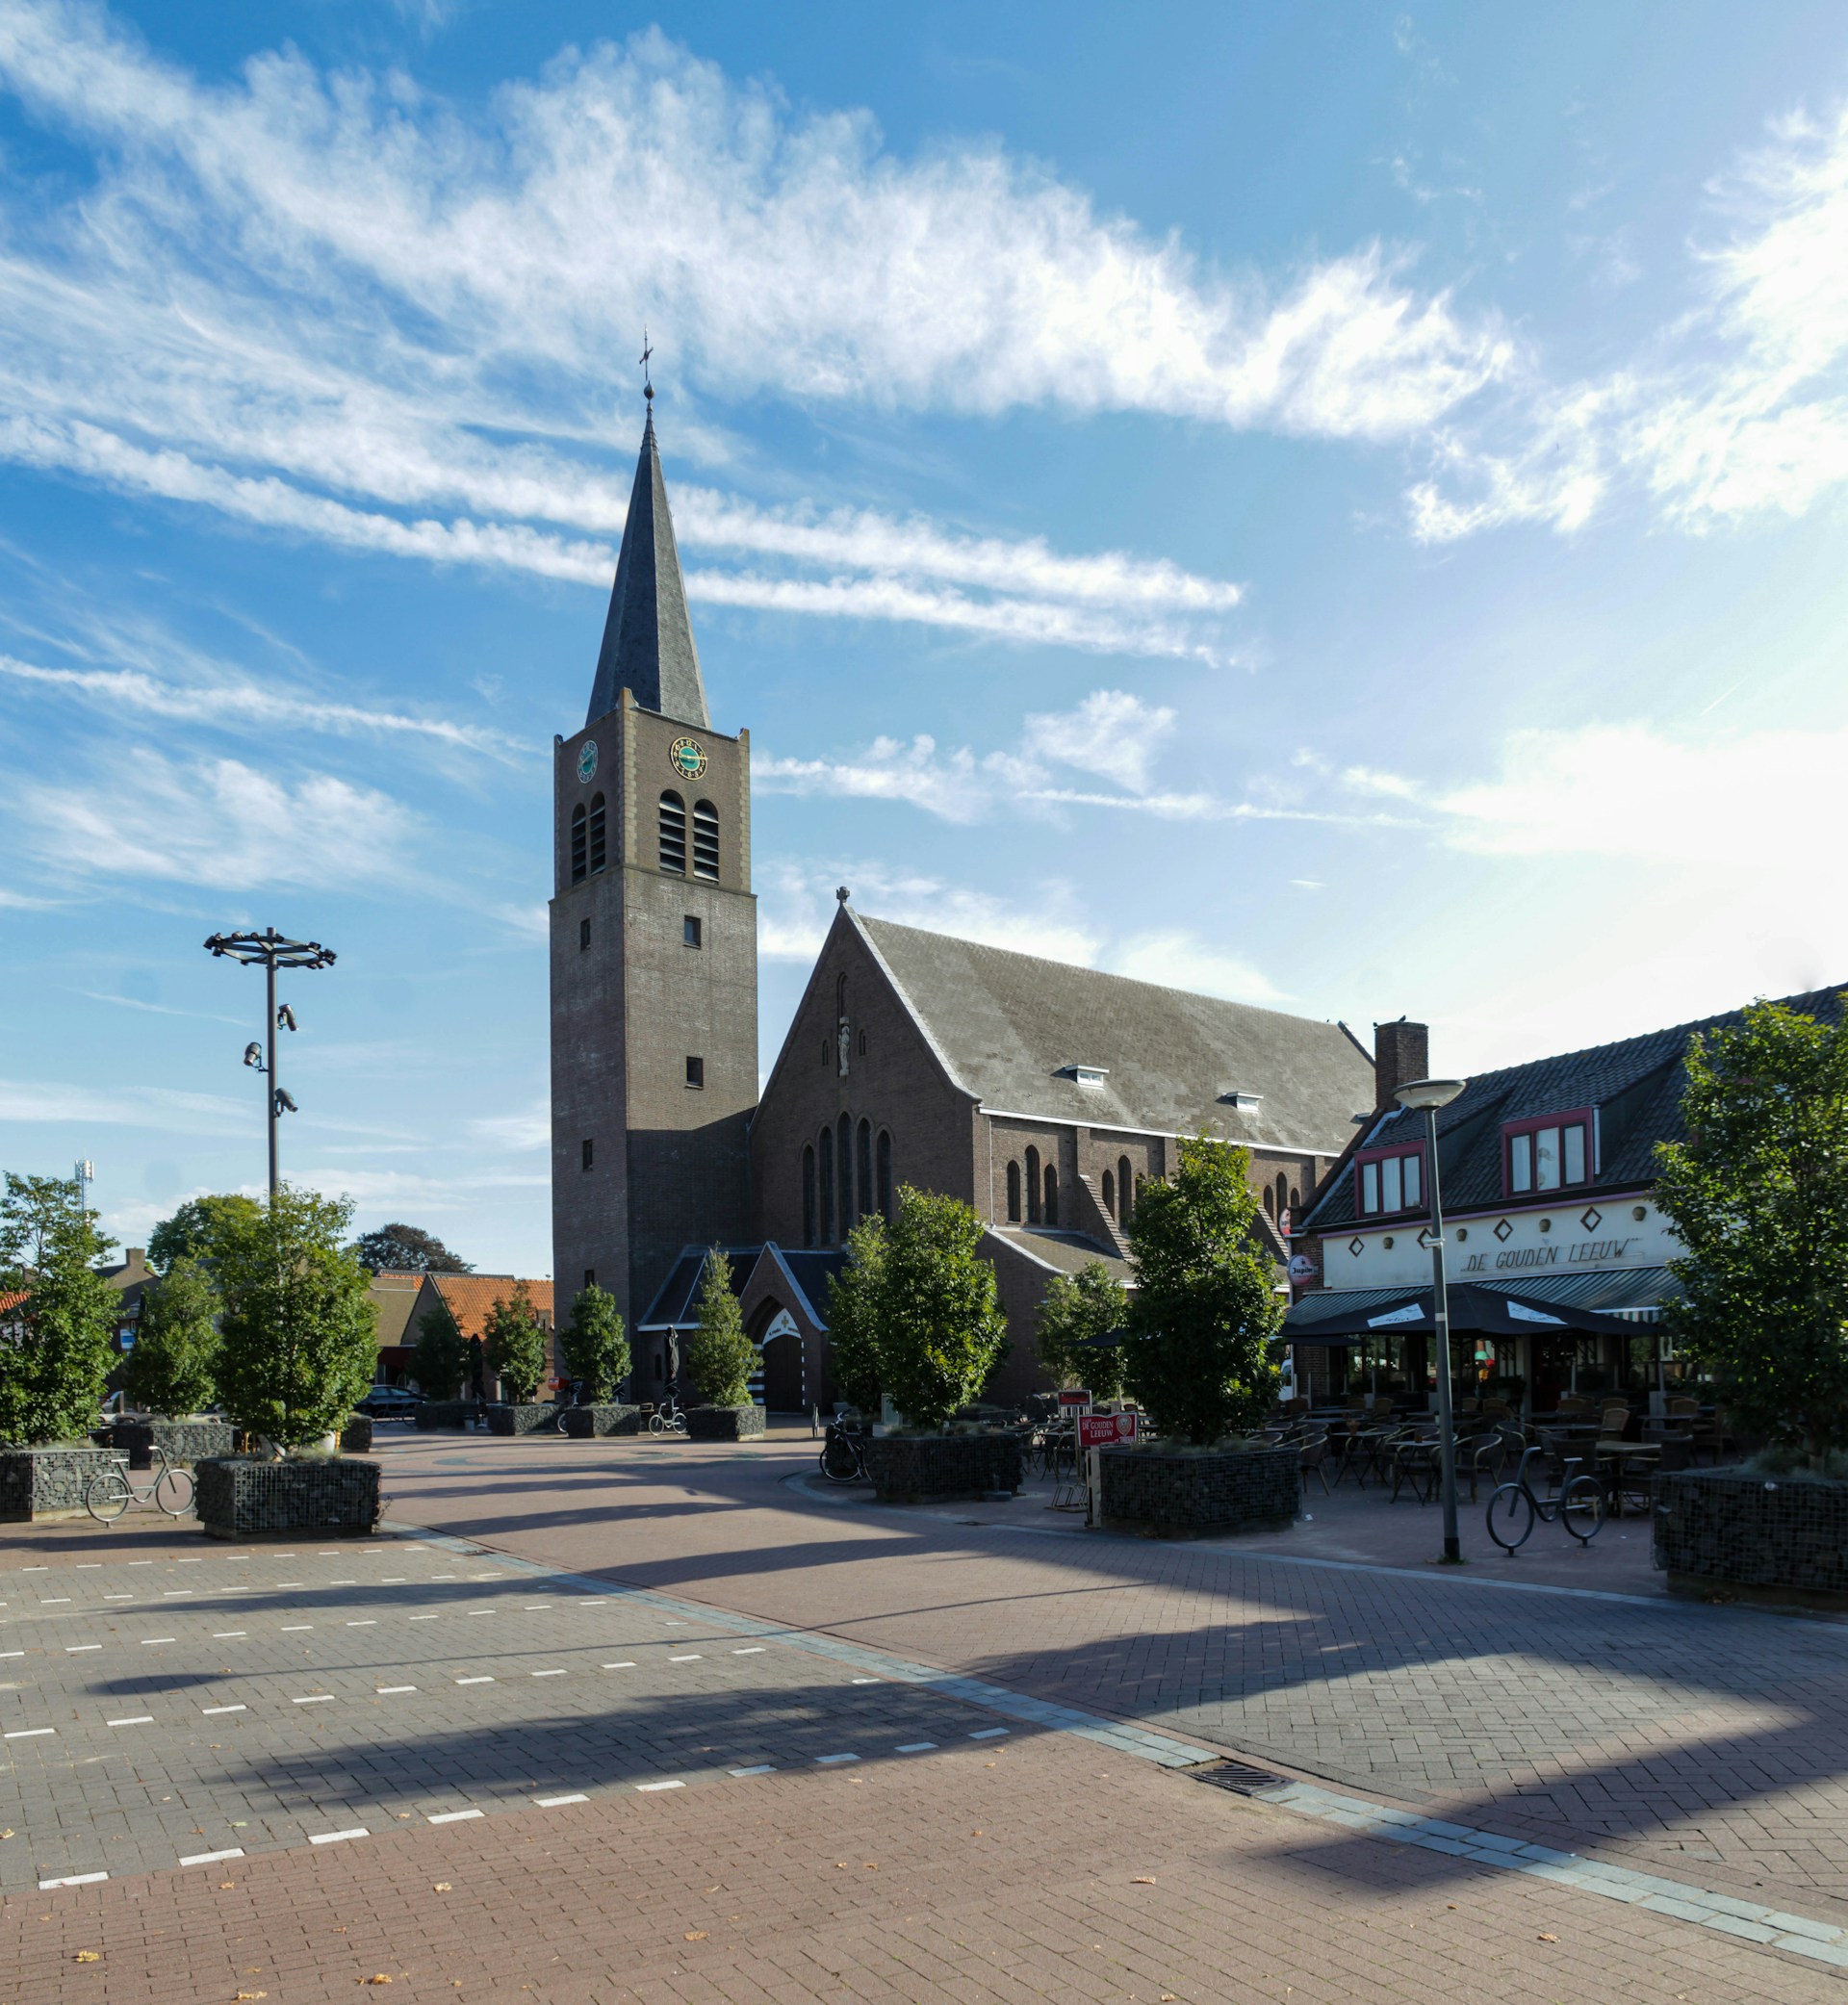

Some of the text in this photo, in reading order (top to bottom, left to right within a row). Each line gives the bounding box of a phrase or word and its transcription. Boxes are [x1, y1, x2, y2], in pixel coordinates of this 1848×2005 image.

[1496, 1246, 1559, 1269] GOUDEN
[1091, 1421, 1114, 1430] GOUDEN
[1091, 1429, 1114, 1438] LEEUW
